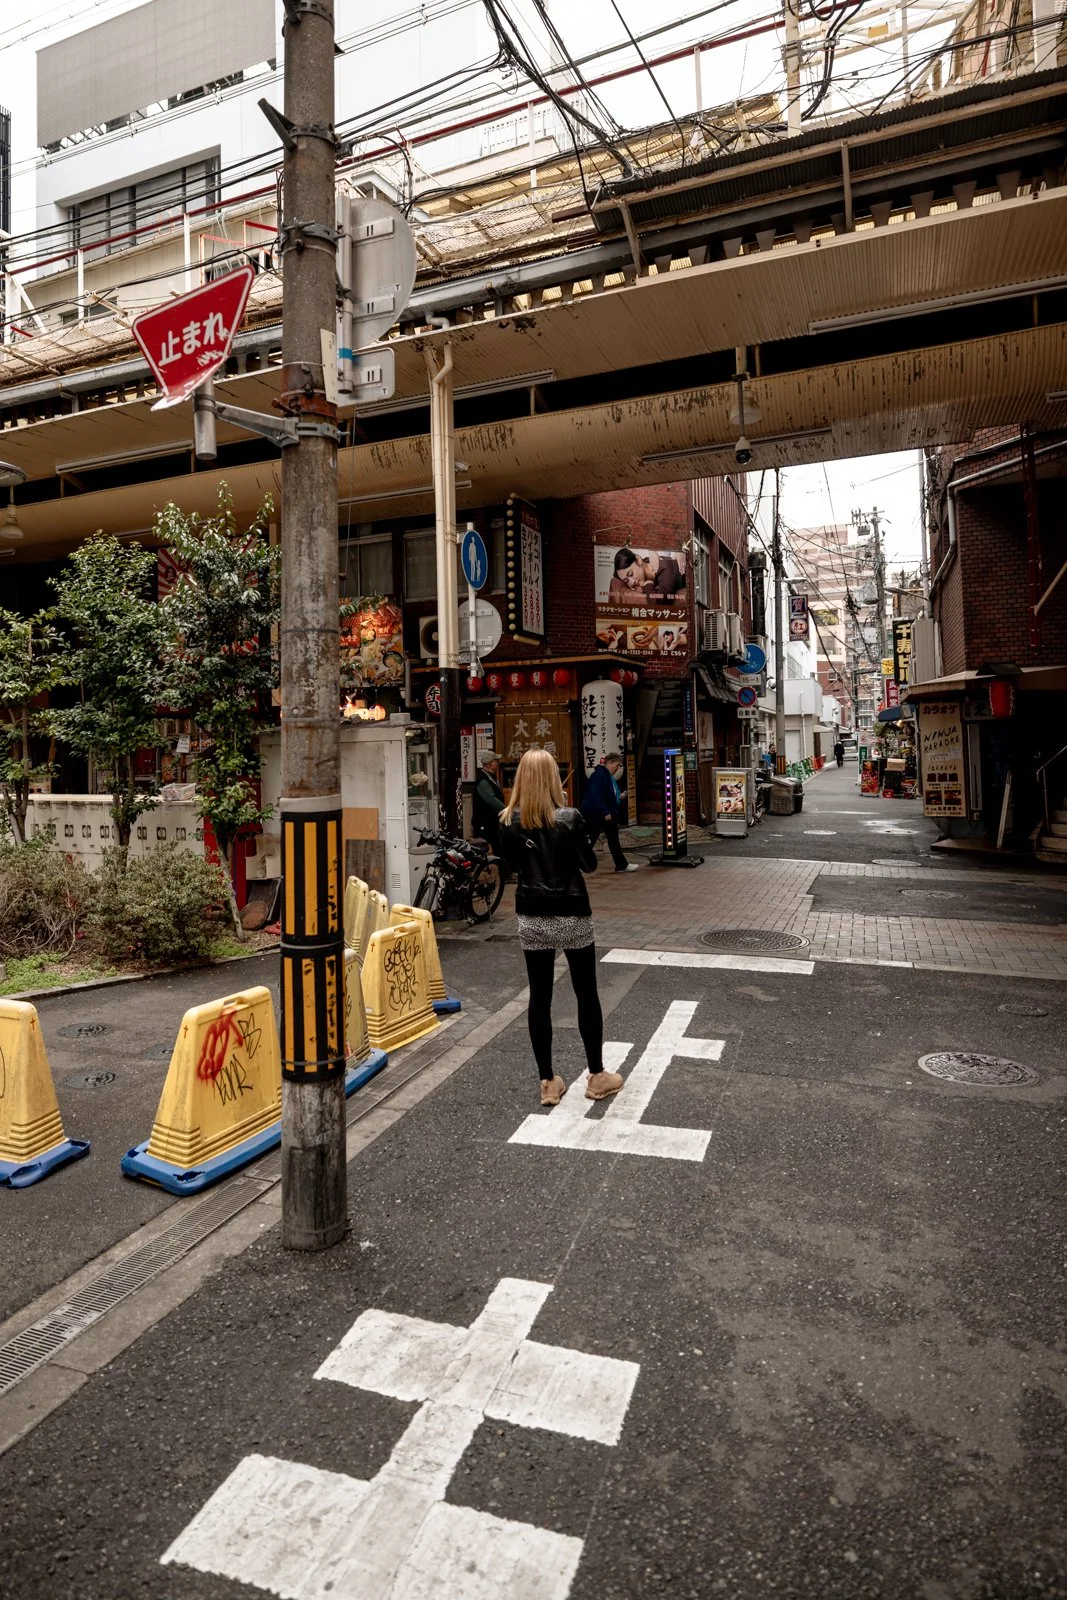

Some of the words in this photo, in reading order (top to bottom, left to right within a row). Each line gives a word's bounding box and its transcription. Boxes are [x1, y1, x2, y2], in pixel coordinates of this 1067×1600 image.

[158, 312, 229, 367] 止まれ
[426, 685, 441, 713] 寿司
[923, 704, 958, 714] カラオケ
[512, 718, 552, 738] 大衆
[582, 694, 599, 769] 乾杯屋
[923, 726, 957, 743] NINJA
[924, 735, 961, 753] KARAOKE
